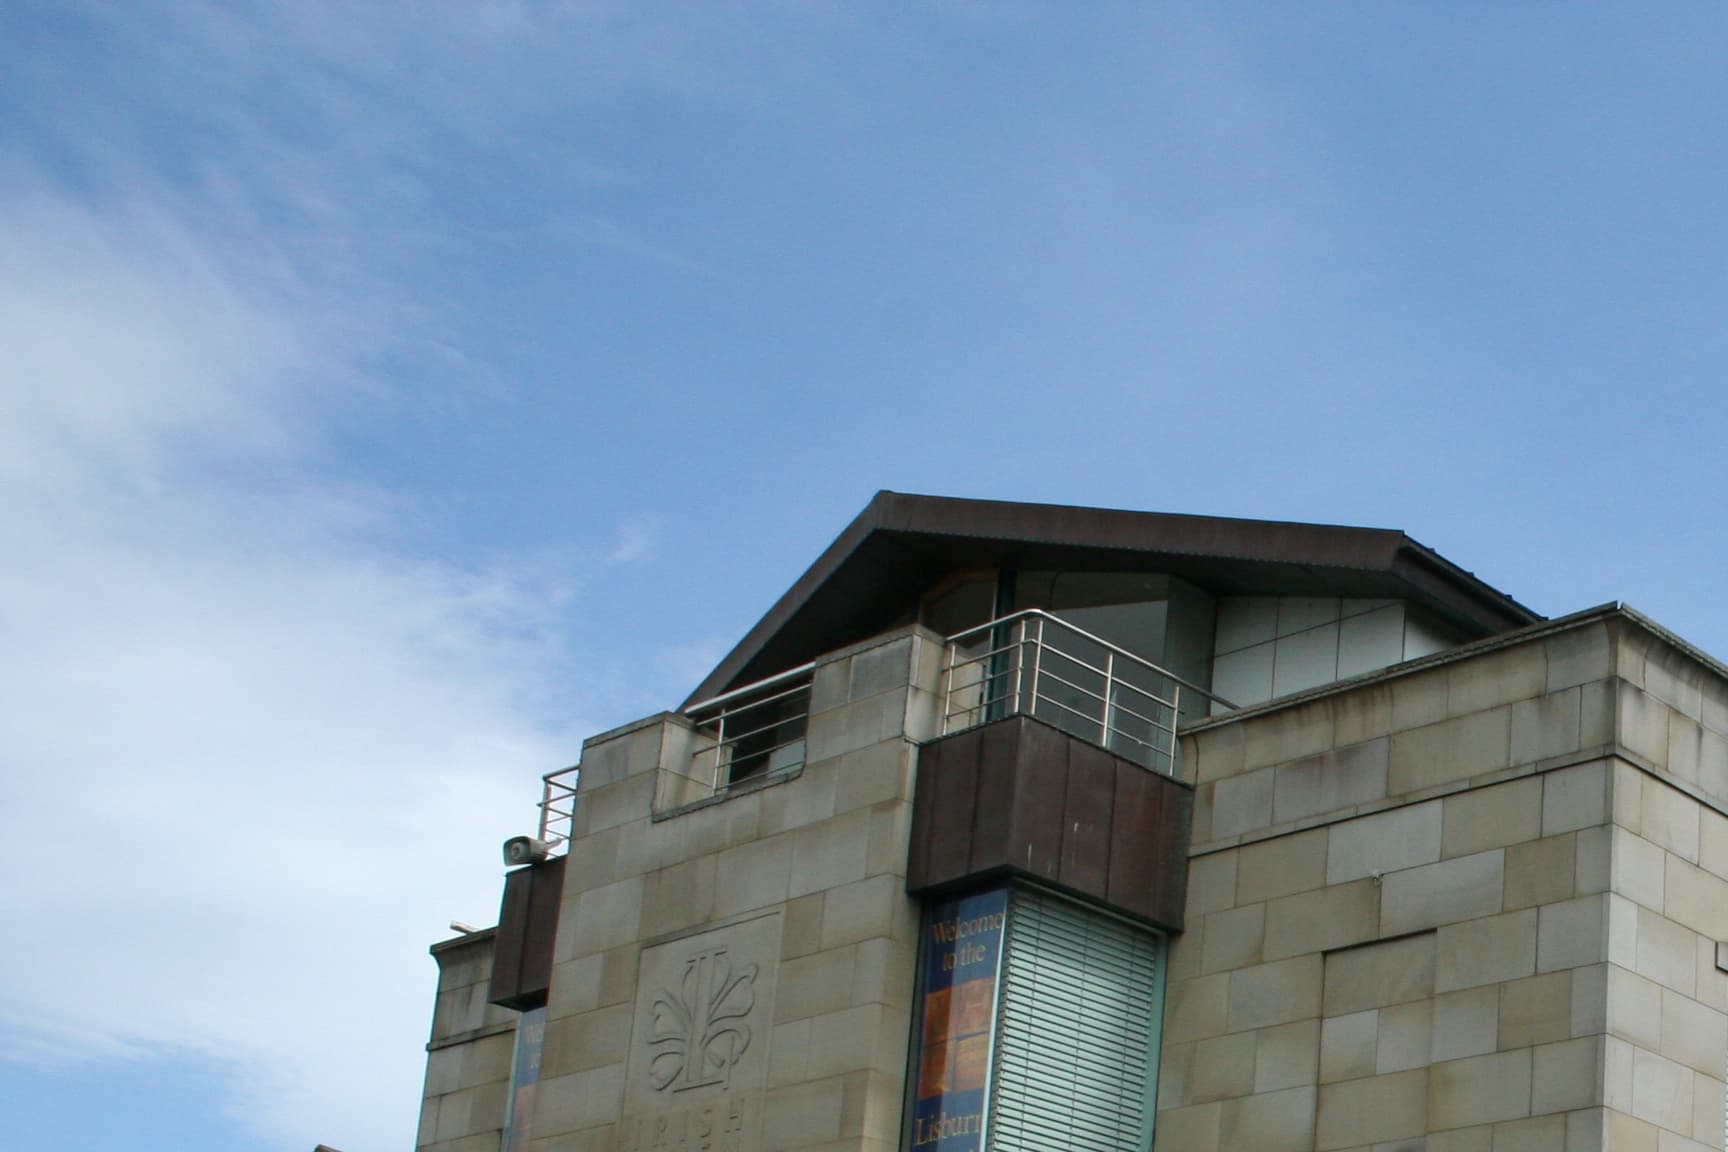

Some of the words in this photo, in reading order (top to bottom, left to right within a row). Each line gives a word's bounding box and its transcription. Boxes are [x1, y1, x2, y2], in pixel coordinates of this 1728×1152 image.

[943, 951, 957, 971] to
[960, 942, 986, 966] the
[630, 1098, 745, 1152] IRISH
